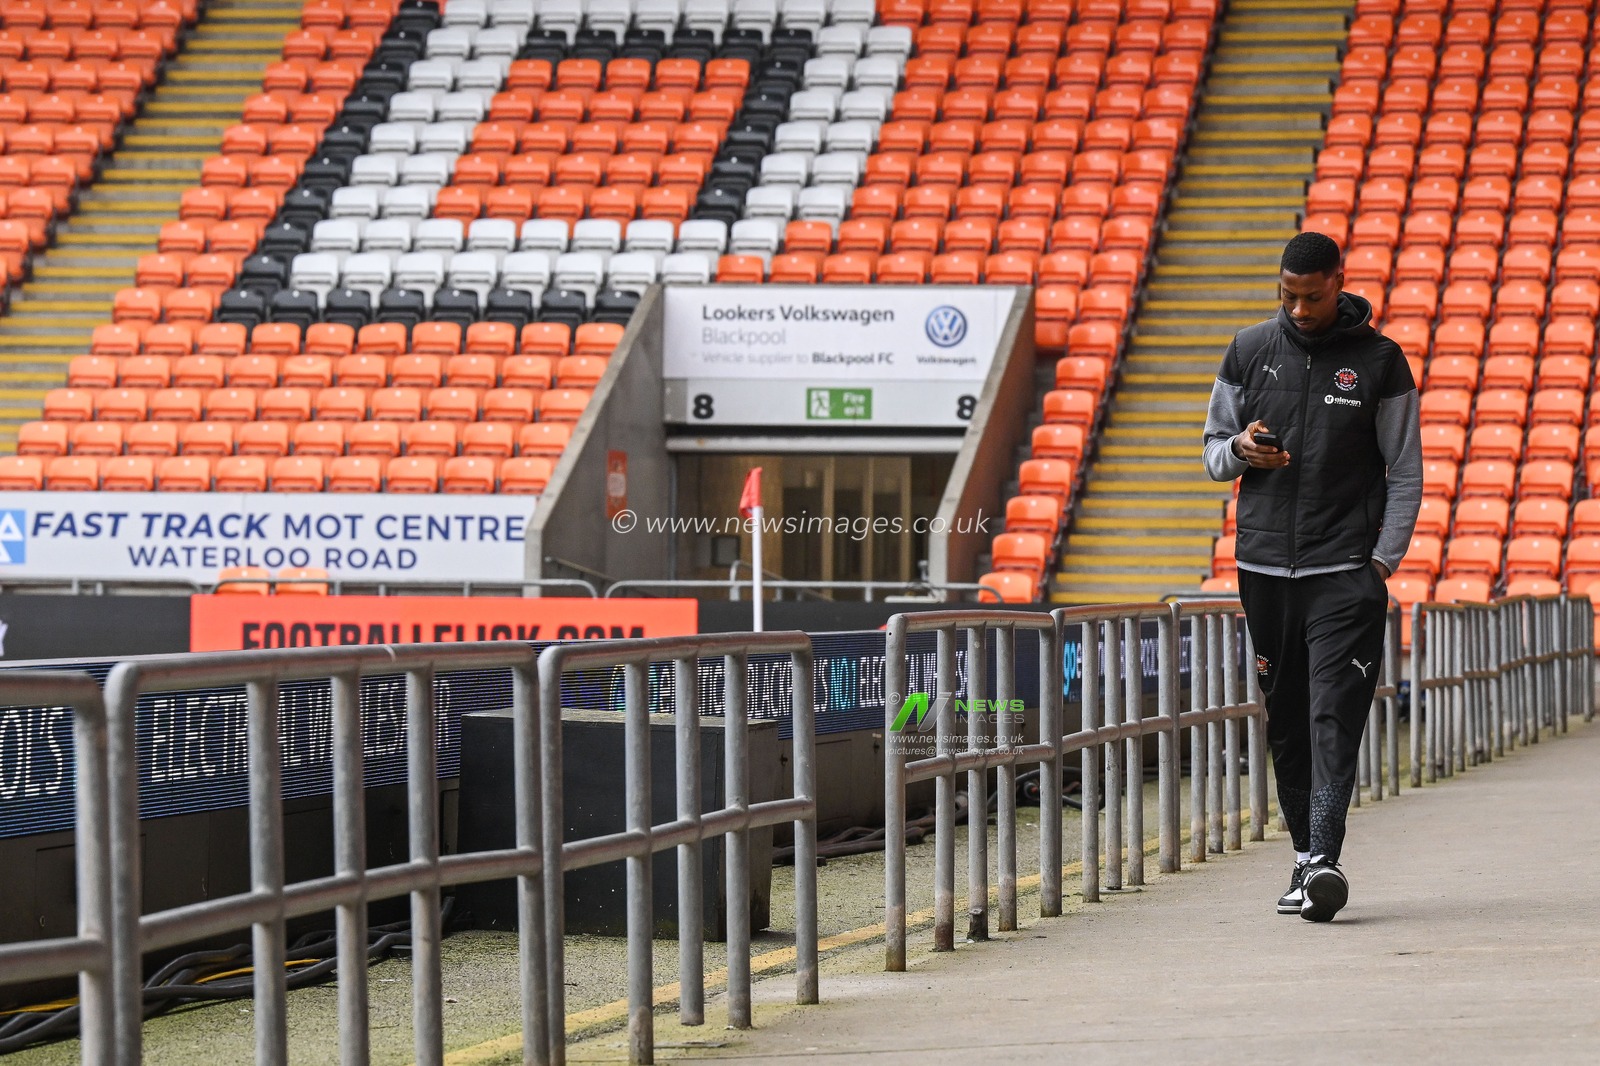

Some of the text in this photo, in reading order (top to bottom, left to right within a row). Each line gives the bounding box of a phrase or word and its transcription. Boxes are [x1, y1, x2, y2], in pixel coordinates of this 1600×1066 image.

[702, 304, 895, 326] Lookers Volkswagen
[702, 326, 786, 346] Blackpool
[811, 352, 875, 366] Blackpool
[878, 352, 894, 364] FC
[916, 355, 977, 367] Volkswagen
[692, 394, 715, 420] 8
[956, 394, 977, 420] 8
[1334, 396, 1362, 406] eleven
[32, 511, 526, 542] FAST TRACK MOT CENTRE
[127, 546, 417, 569] WATERLOO ROAD
[151, 690, 302, 783] ELECTRAL
